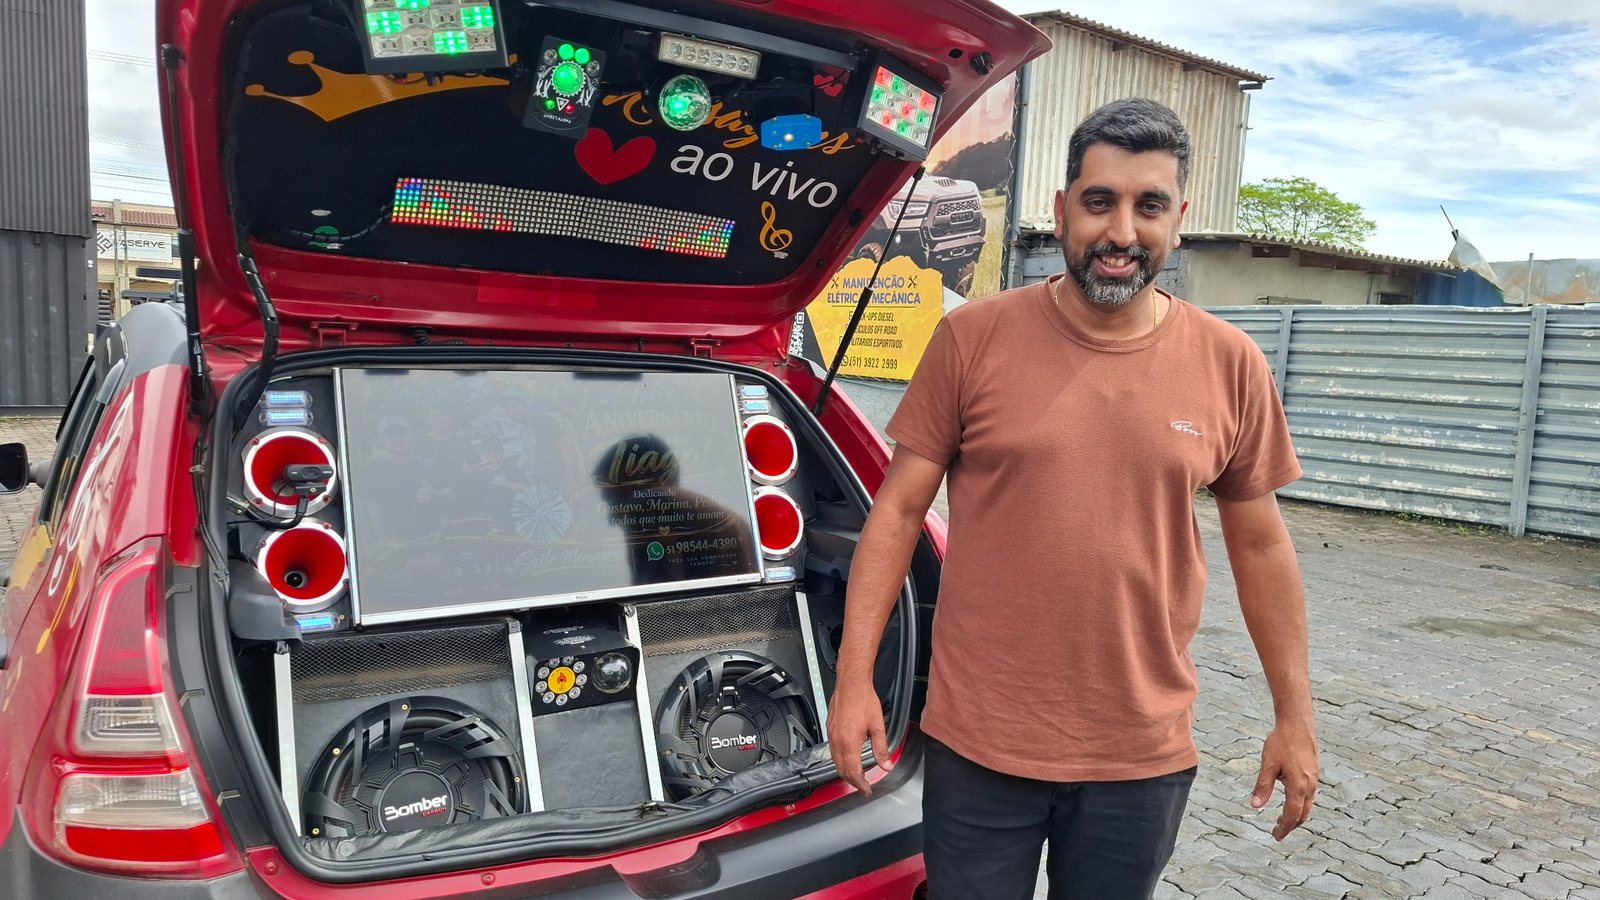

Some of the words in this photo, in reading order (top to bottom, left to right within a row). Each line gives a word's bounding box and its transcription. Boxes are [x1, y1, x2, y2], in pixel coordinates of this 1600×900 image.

[670, 144, 734, 181] ao
[751, 161, 838, 208] vivo
[842, 275, 905, 289] MANUENÇÃO
[827, 290, 861, 304] ELÉTRIC
[871, 290, 921, 304] MECÂNICA
[878, 312, 895, 322] DIESEL
[849, 356, 862, 368] (51)
[864, 357, 880, 369] 3922
[882, 358, 898, 370] 2999
[633, 489, 677, 499] Dedicando
[646, 498, 692, 512] Marina,
[659, 512, 685, 523] muito
[687, 511, 695, 521] te
[697, 511, 725, 520] amam
[666, 545, 675, 554] 51
[676, 537, 738, 553] 98544-4380
[711, 734, 757, 750] Bomber
[384, 794, 448, 821] Bomber
